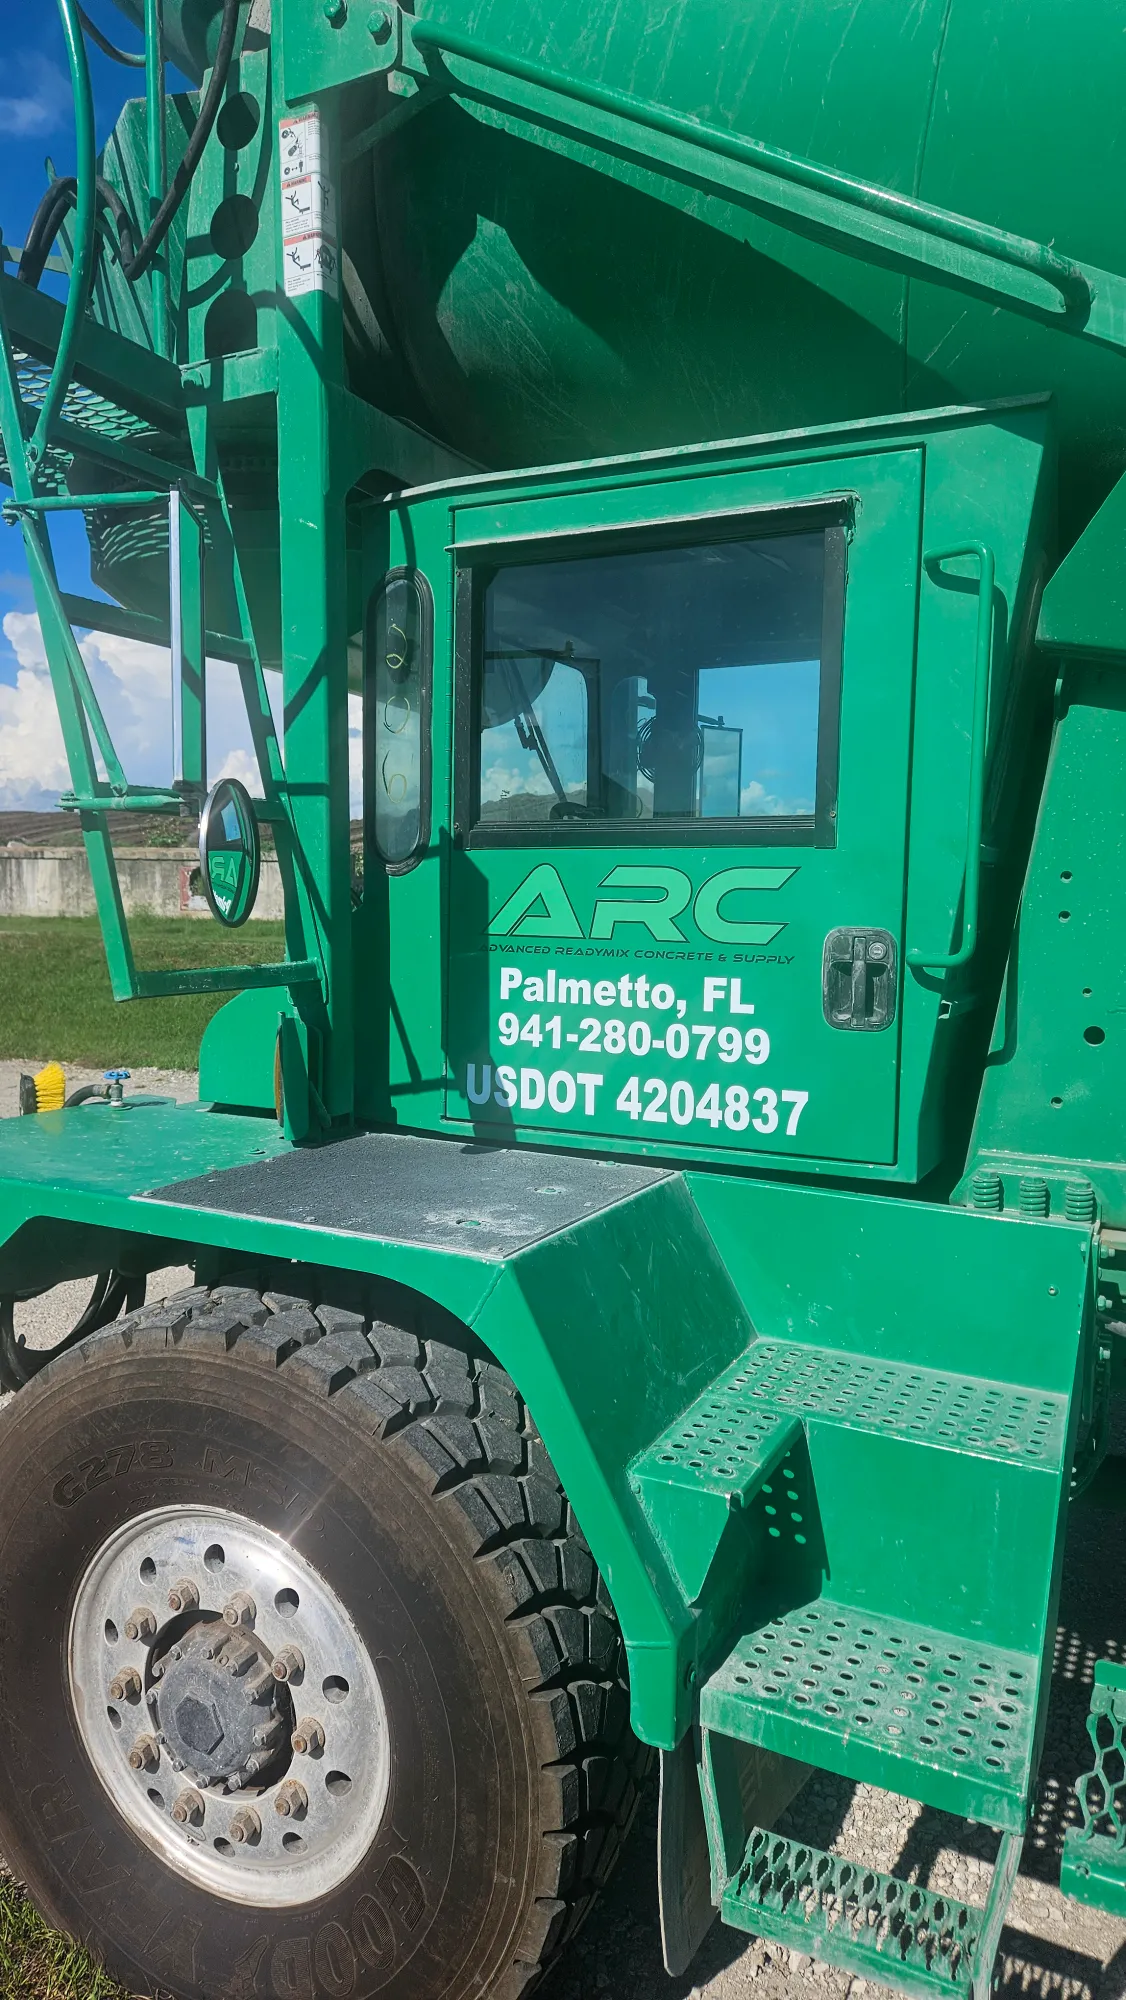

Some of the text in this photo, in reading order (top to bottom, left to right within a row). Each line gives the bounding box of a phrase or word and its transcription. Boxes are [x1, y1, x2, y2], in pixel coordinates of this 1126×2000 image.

[481, 862, 802, 946] ARC
[480, 944, 796, 965] ADVANCED READYMIX CONCRETE & SUPPLY
[500, 966, 756, 1020] Palmetto, FL
[498, 1011, 771, 1066] 941-280-0799
[466, 1063, 809, 1136] USDOT 4204837
[52, 1440, 174, 1509] G278
